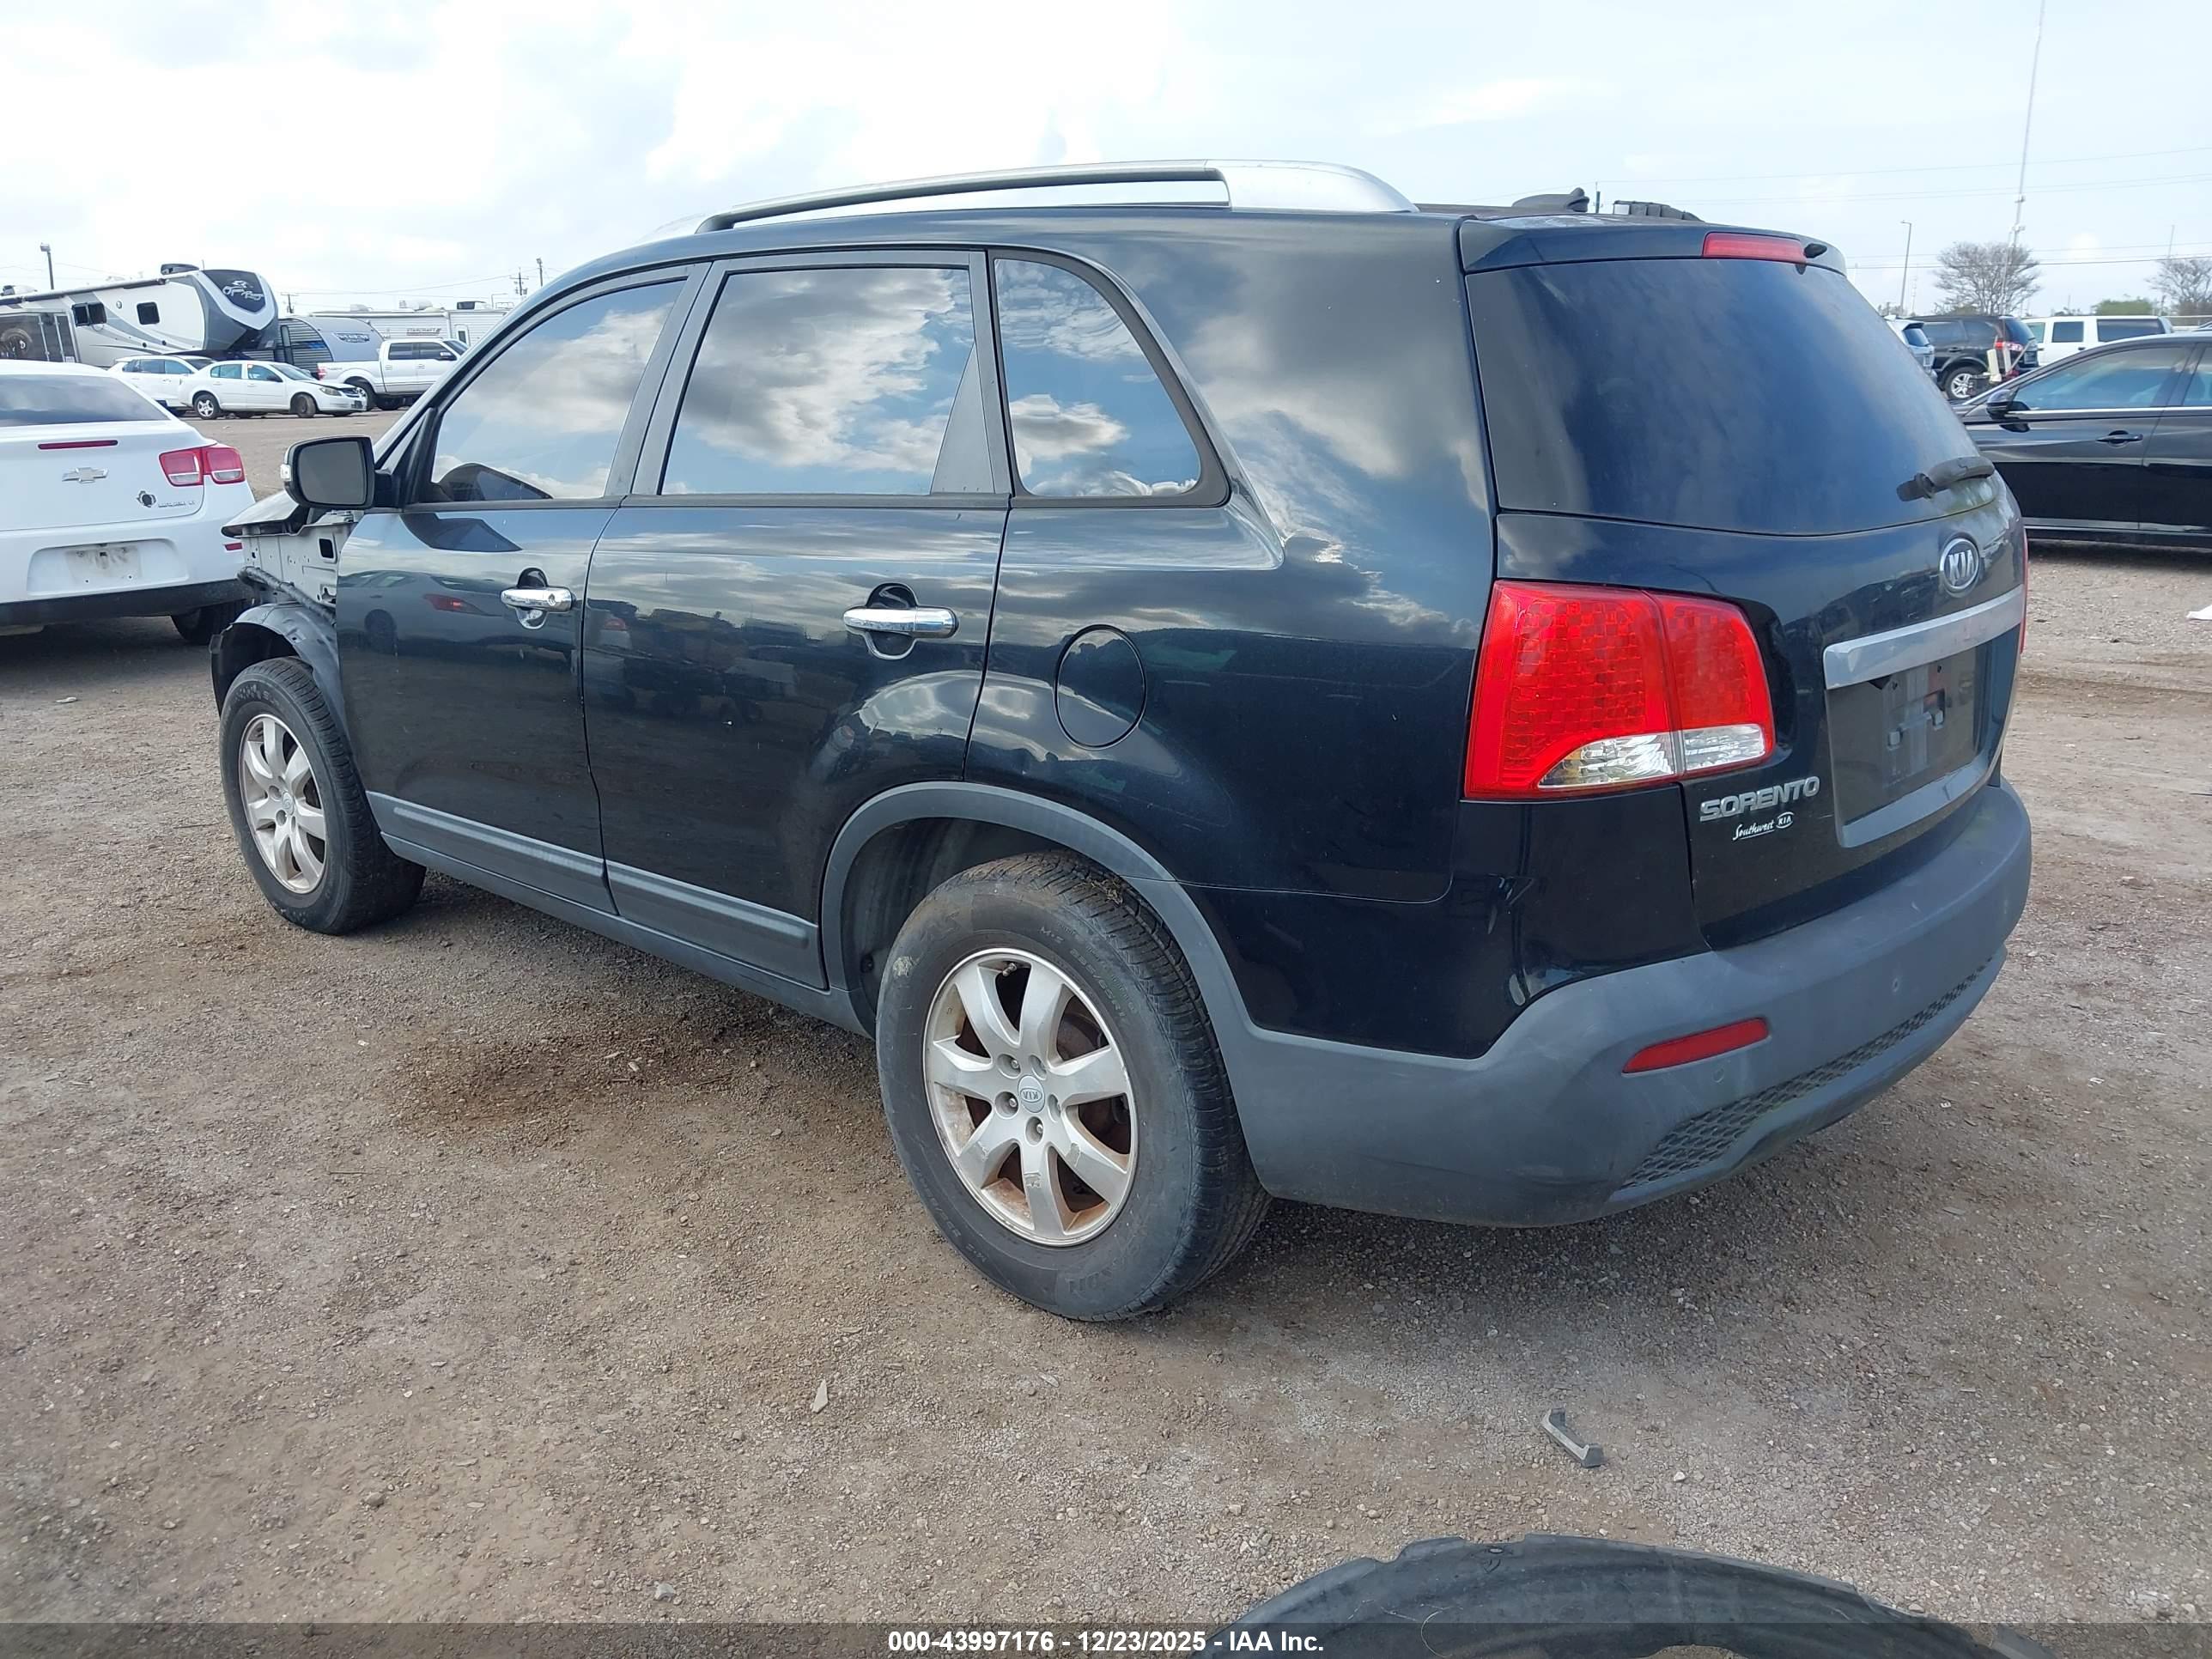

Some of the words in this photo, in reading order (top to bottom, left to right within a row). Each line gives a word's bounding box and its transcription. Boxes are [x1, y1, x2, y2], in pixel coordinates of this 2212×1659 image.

[1947, 549, 1975, 580] KIA
[1699, 775, 1820, 822] SORENTO
[1732, 819, 1775, 842] Southwest
